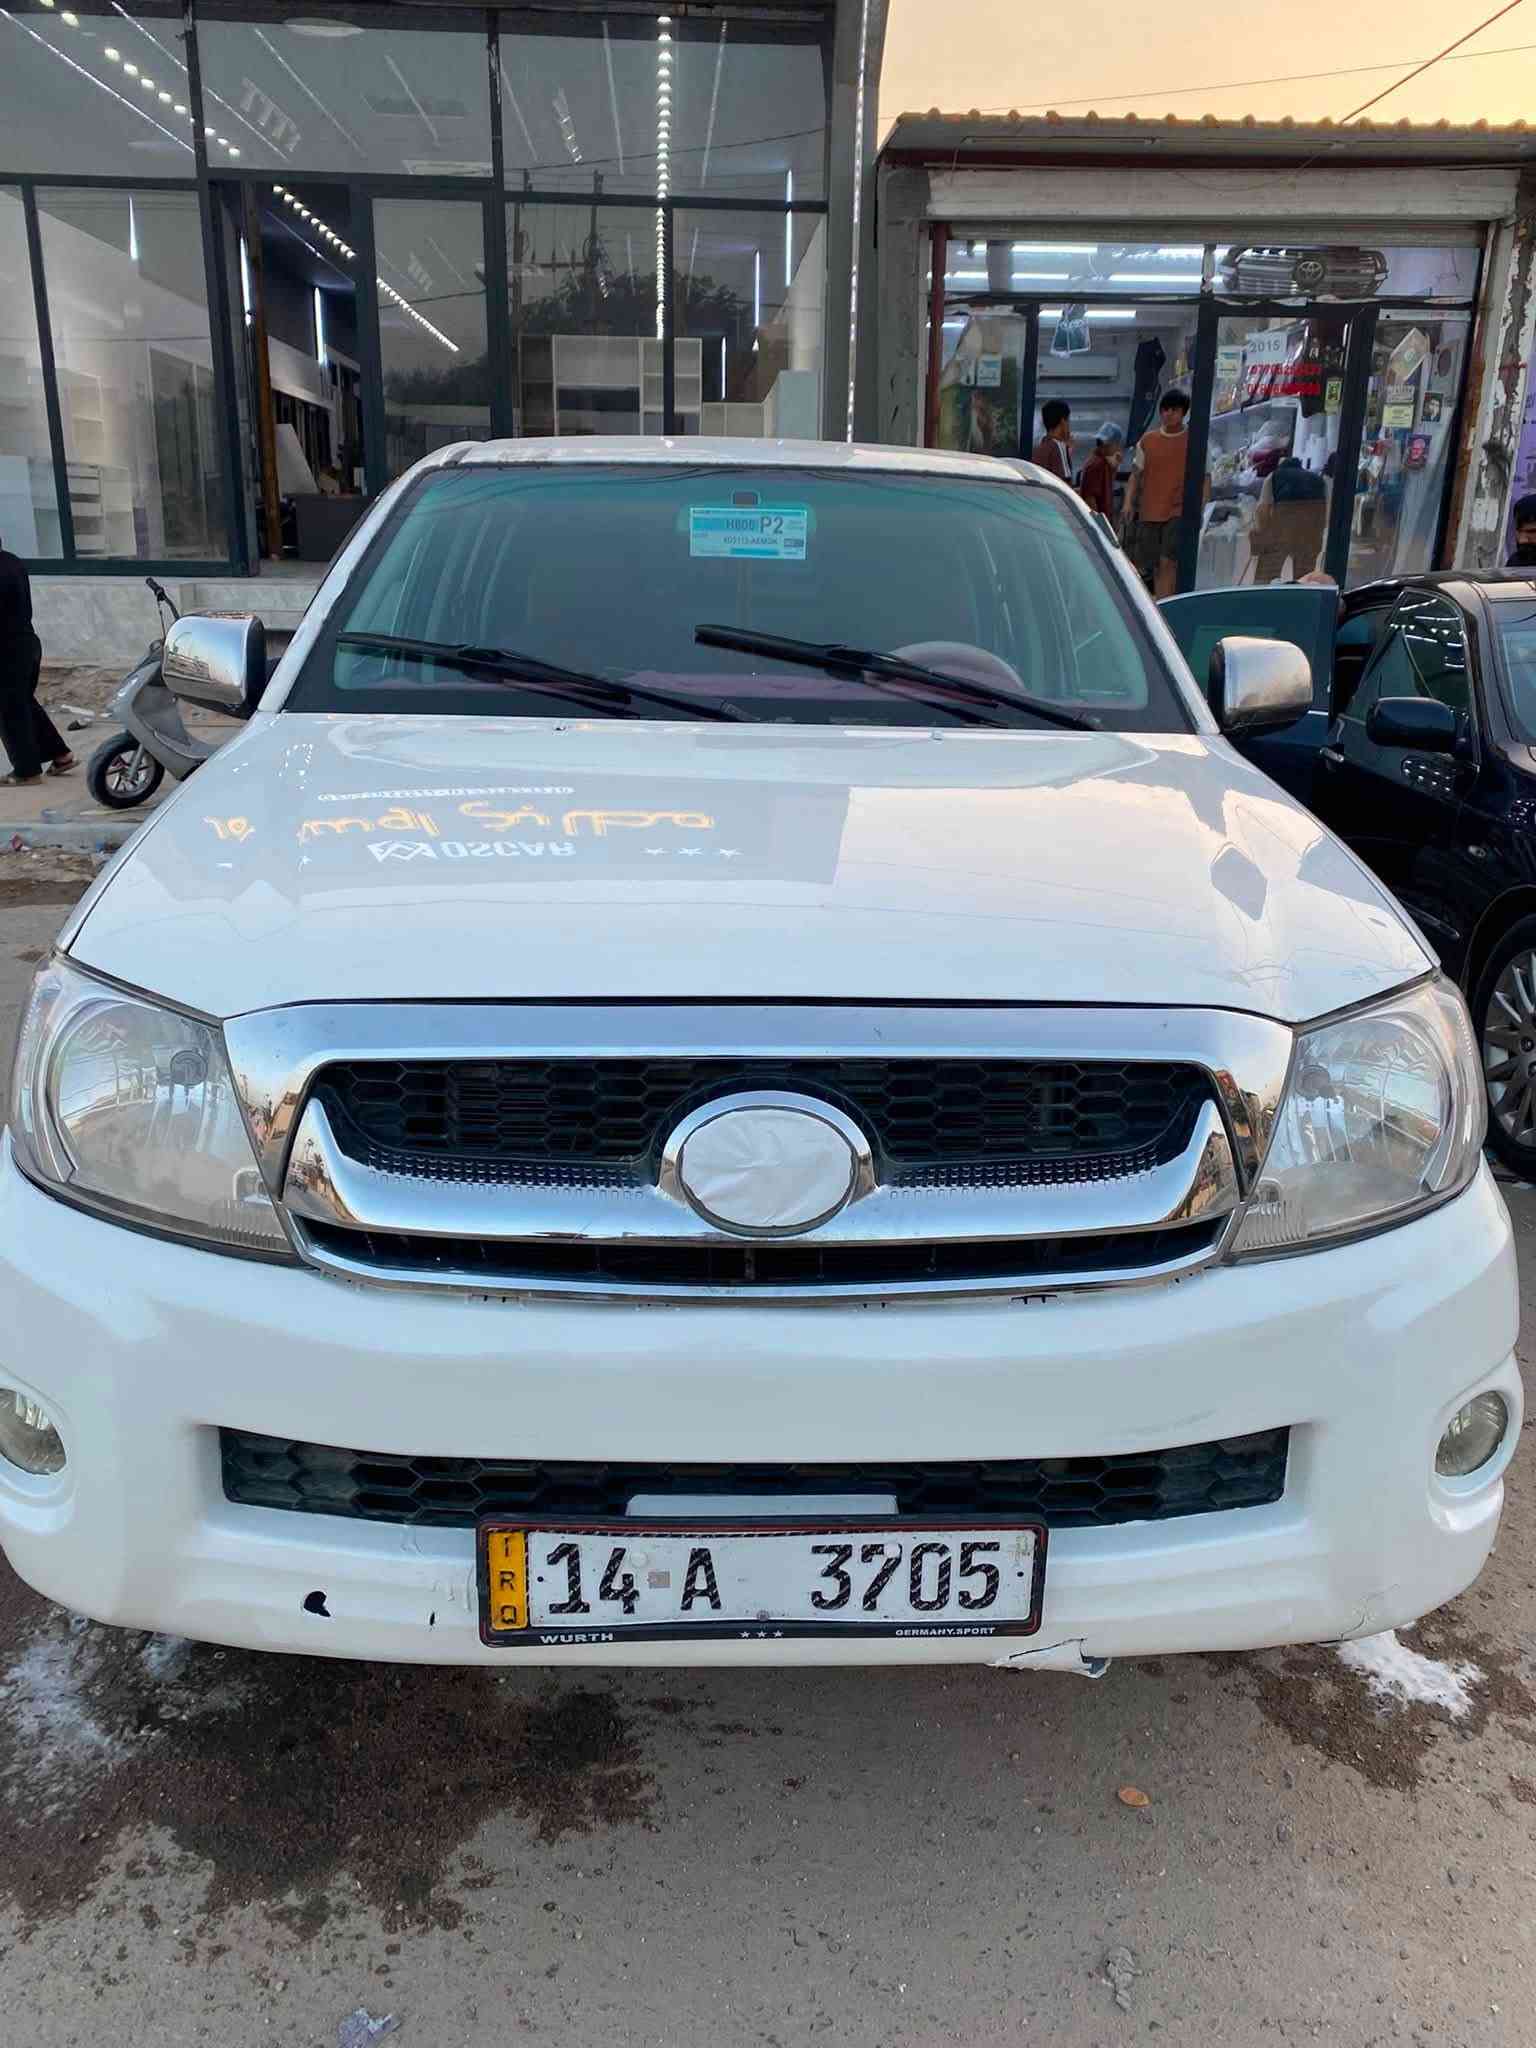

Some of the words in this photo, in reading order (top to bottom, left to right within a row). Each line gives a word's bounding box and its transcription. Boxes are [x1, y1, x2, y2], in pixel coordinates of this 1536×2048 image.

[1249, 339, 1281, 353] 2015
[759, 516, 784, 535] P2
[546, 1542, 640, 1615] 14
[679, 1547, 722, 1611] A
[810, 1541, 1001, 1612] 3705
[540, 1632, 614, 1645] WURTH
